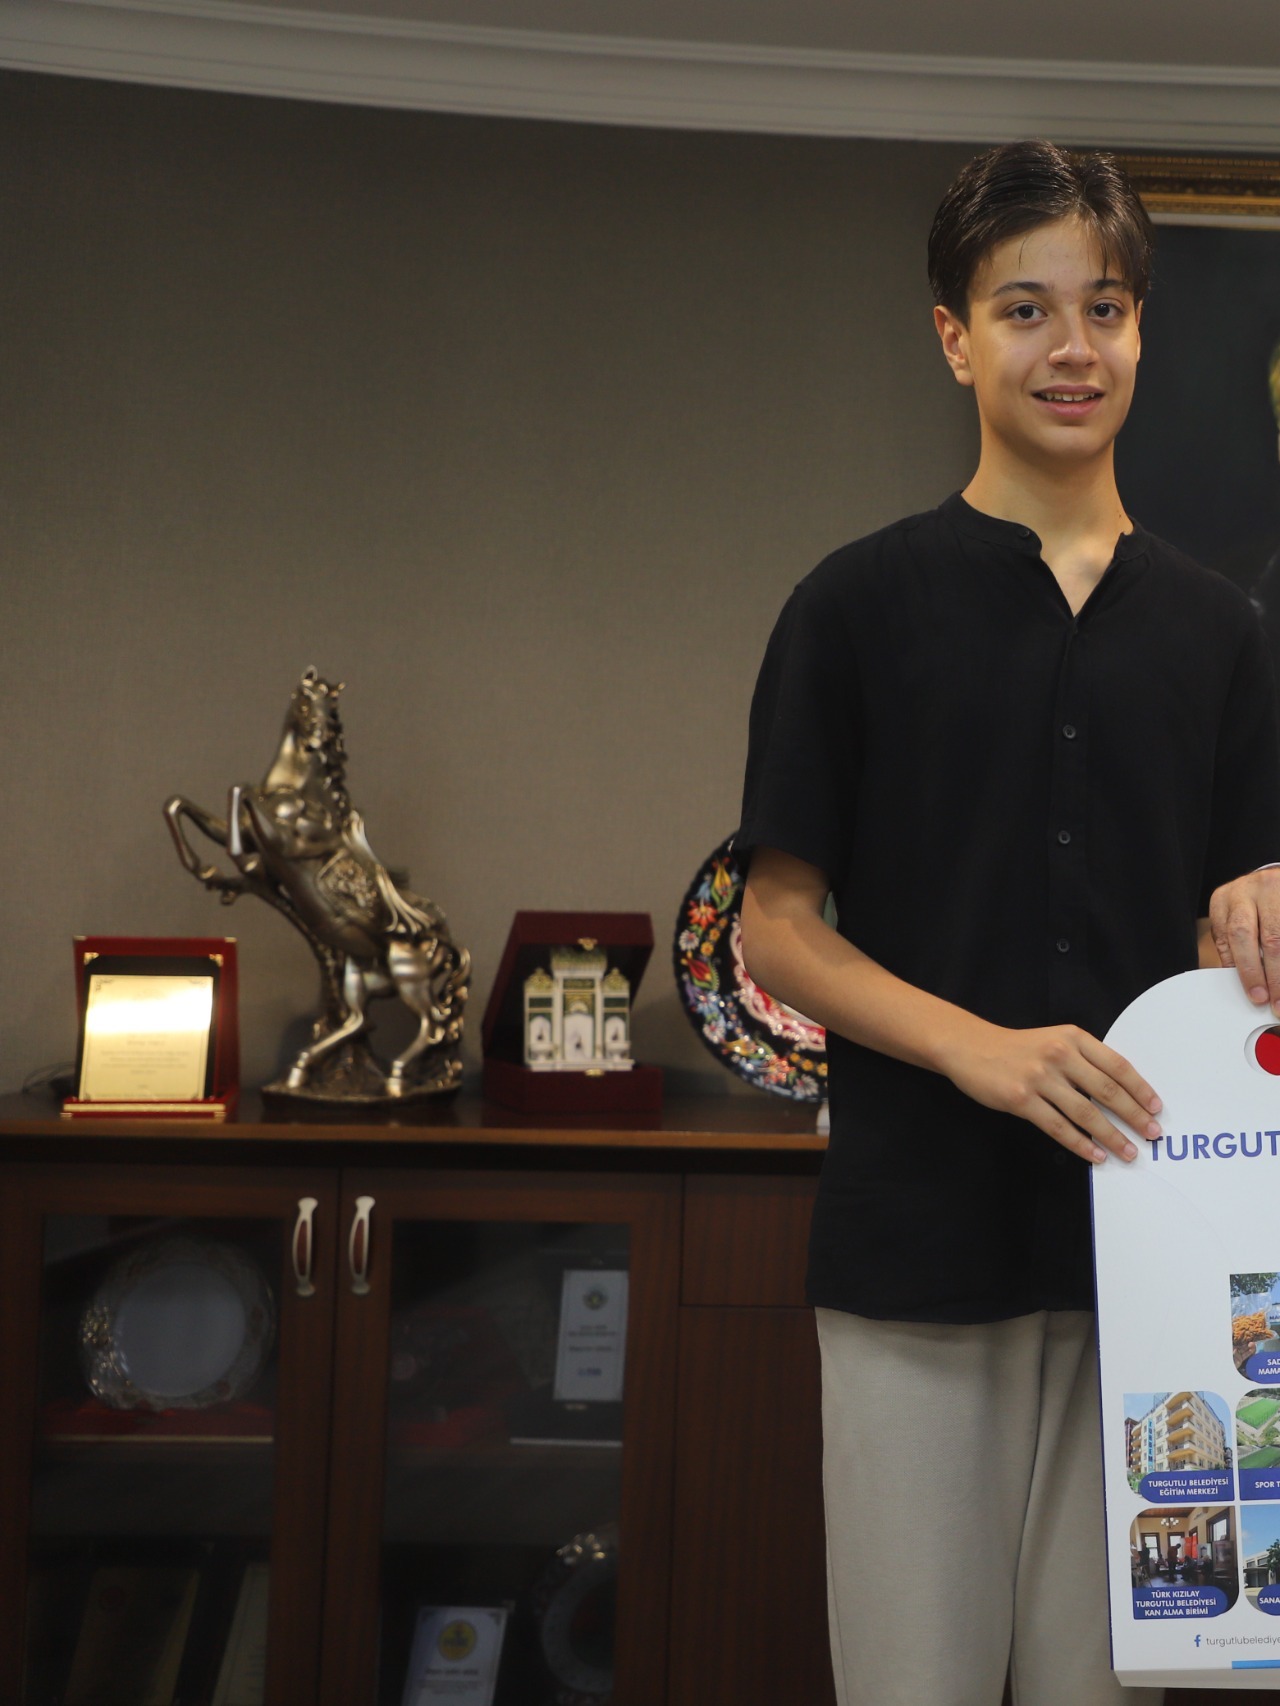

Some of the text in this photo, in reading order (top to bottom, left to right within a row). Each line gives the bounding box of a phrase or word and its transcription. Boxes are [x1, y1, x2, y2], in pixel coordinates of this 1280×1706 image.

[1148, 1476, 1229, 1488] TURGUTLU BELEDİYESİ
[1255, 1480, 1275, 1489] SPOR
[1159, 1486, 1218, 1496] EĞİTİM MERKEZİ
[1151, 1589, 1200, 1598] TÜRK KIZILAY
[1136, 1597, 1216, 1608] TURGUTLU BELEDİYESİ
[1144, 1606, 1208, 1617] KAN ALMA BİRİMİ
